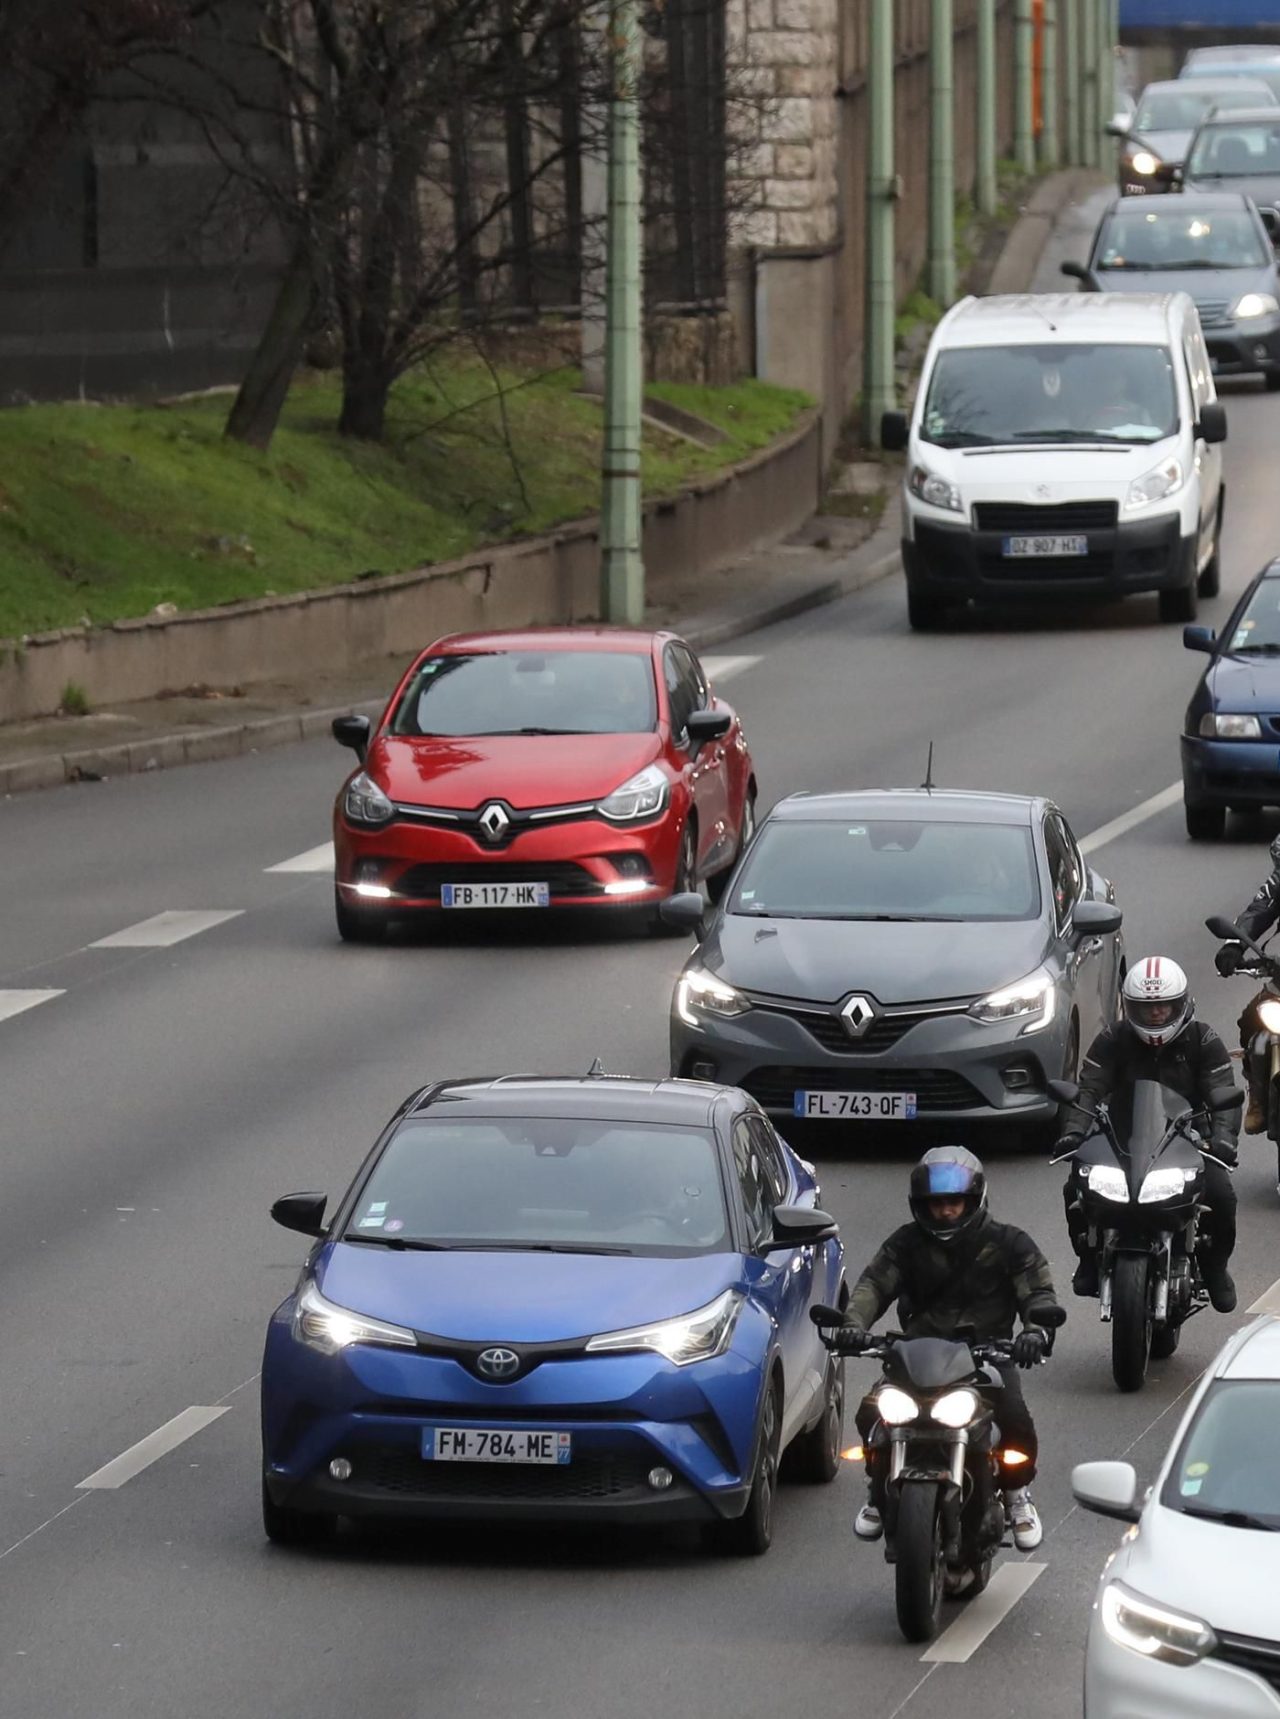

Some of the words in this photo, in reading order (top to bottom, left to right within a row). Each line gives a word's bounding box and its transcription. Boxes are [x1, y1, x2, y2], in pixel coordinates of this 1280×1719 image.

[453, 886, 536, 905] FB-117-HK
[808, 1094, 903, 1116] FL-743-QF
[438, 1431, 554, 1459] FM-784-ME
[558, 1447, 570, 1460] 77
